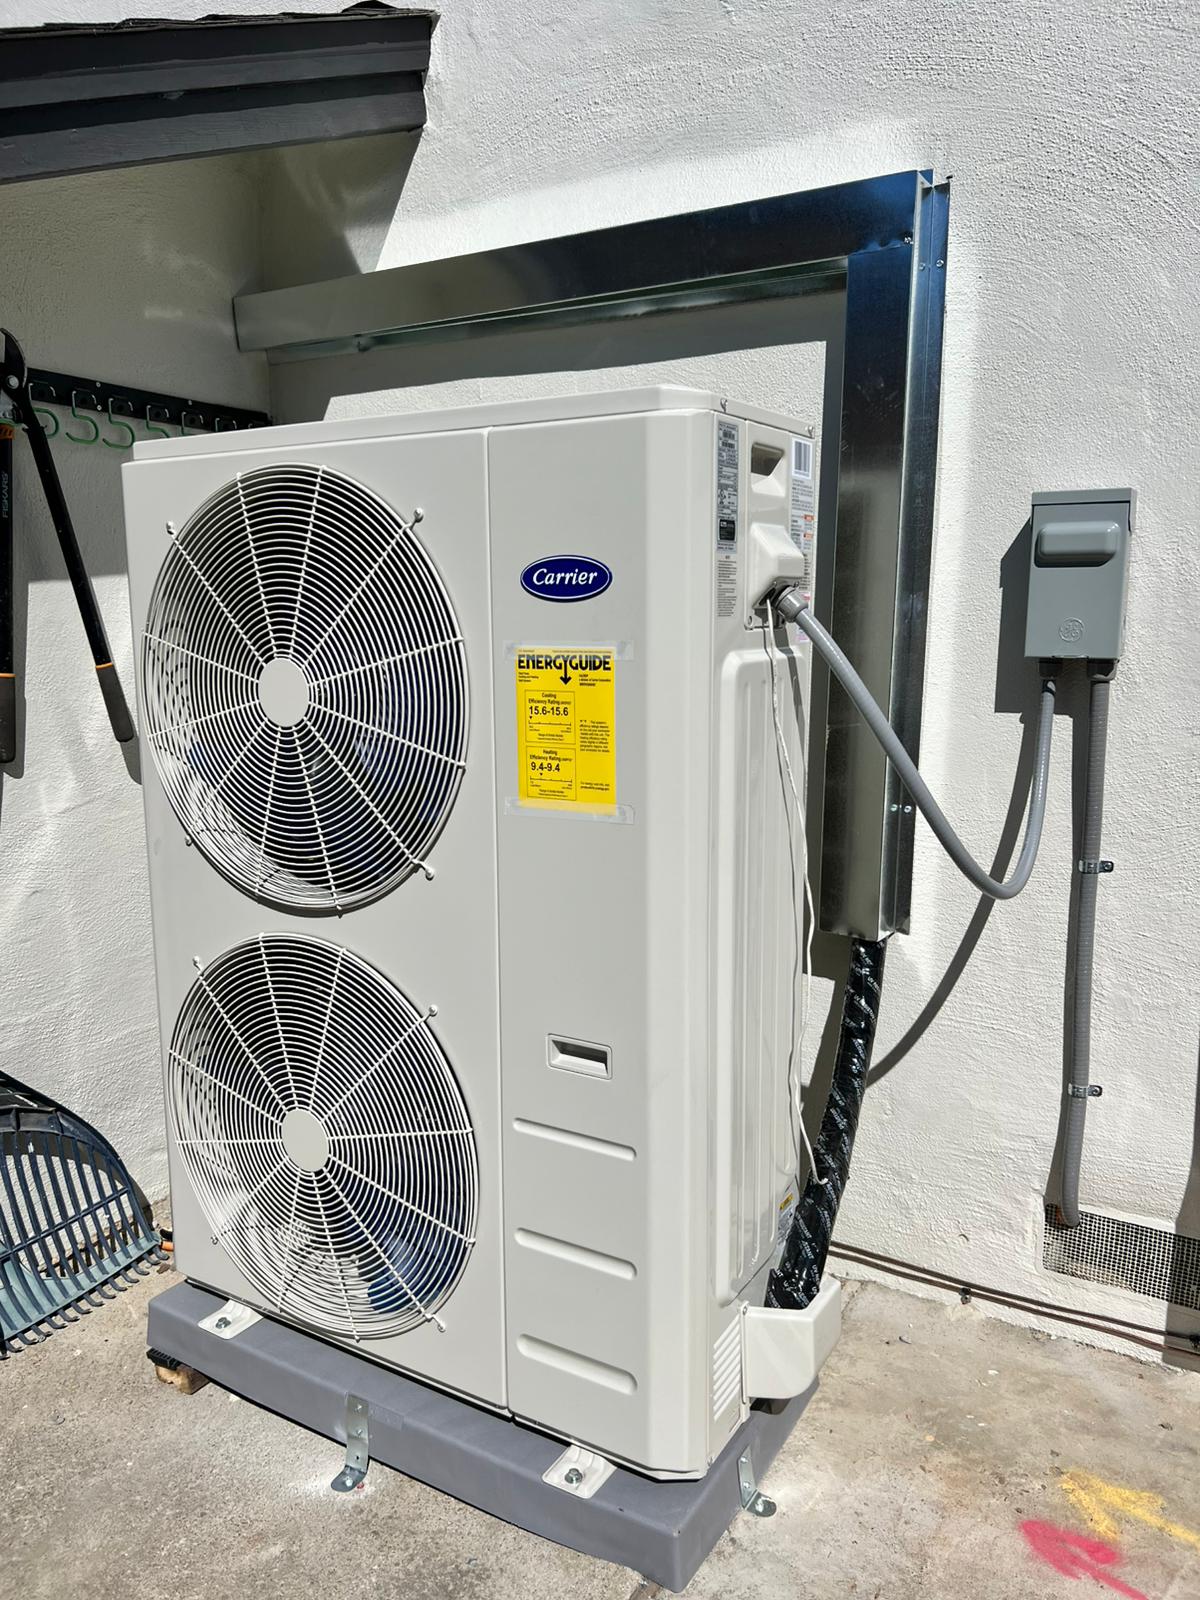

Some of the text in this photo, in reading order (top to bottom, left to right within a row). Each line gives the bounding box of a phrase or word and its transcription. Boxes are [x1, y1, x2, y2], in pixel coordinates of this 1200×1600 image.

[532, 568, 598, 585] Carrier
[517, 654, 612, 672] ENERGYGUIDE
[528, 705, 569, 717] 15.6-15.6
[530, 761, 560, 773] 9.4-9.4
